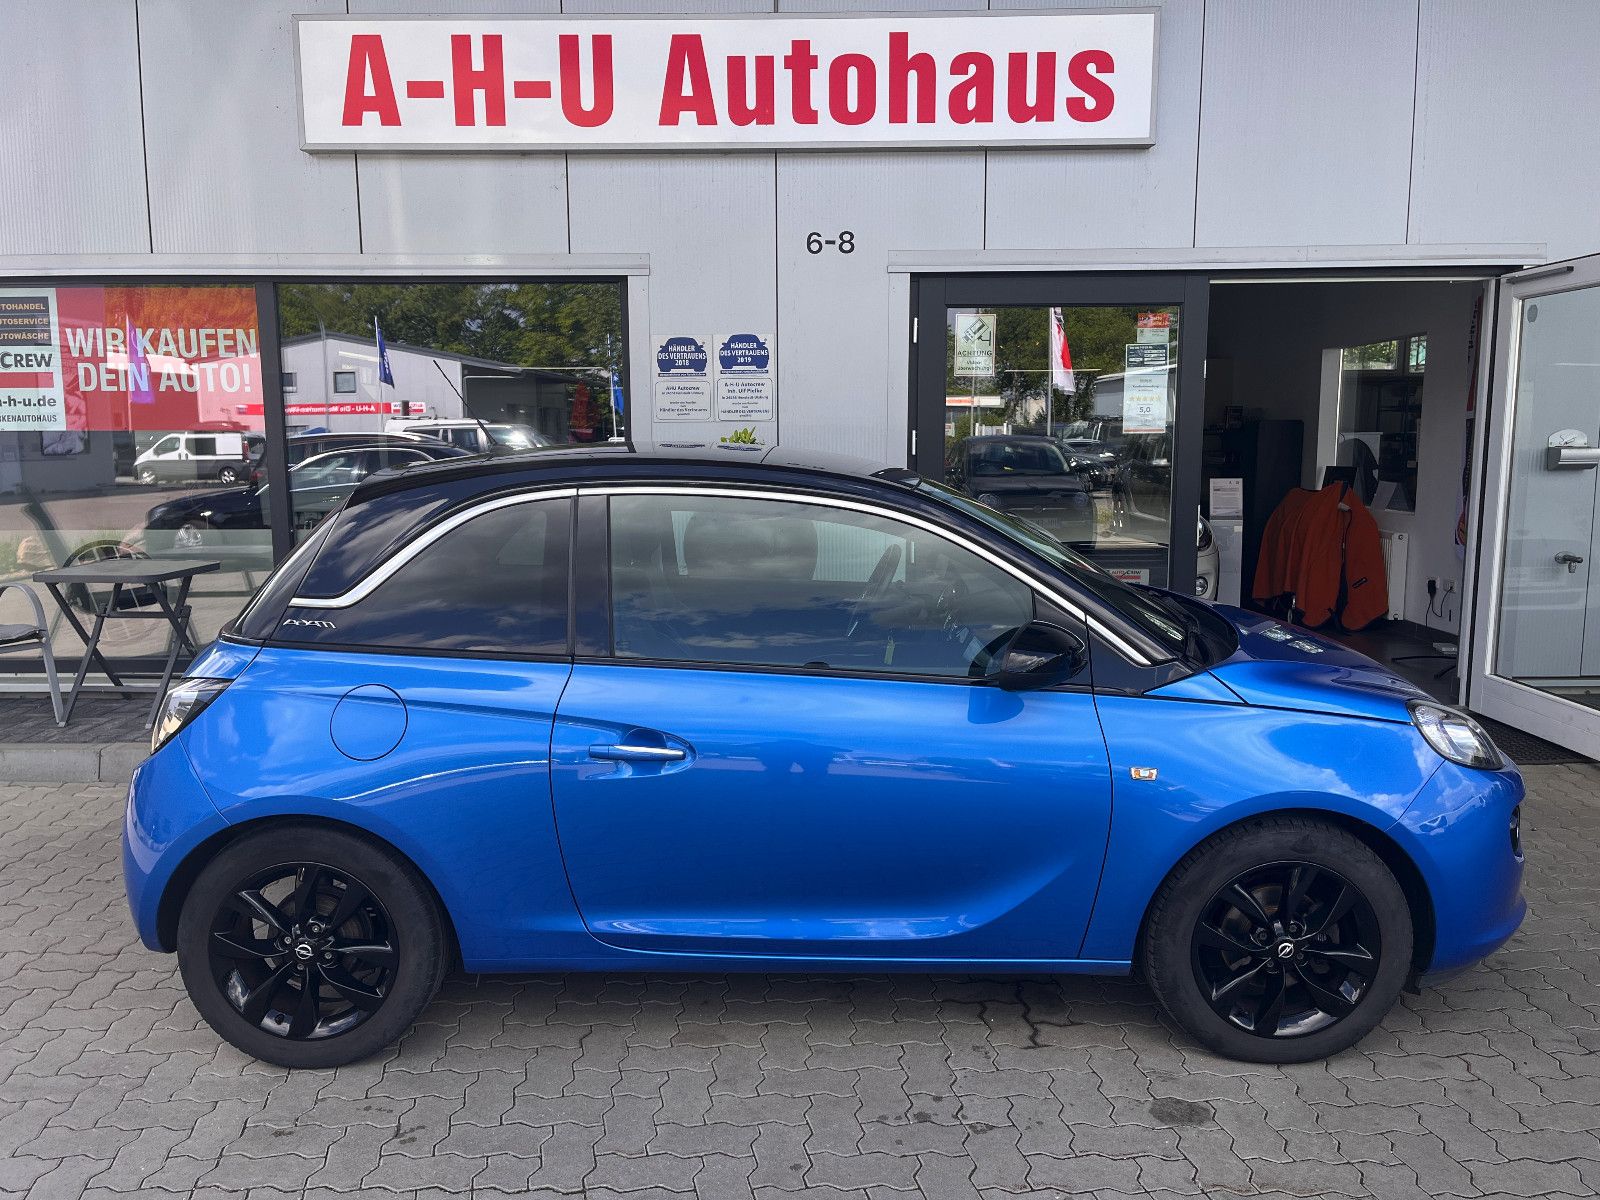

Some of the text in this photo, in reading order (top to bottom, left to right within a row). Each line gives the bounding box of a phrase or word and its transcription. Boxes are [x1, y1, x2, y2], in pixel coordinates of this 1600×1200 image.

[341, 31, 1116, 128] A-H-U Autohaus
[806, 230, 855, 255] 6-8
[0, 303, 46, 311] TOHANDEL
[65, 327, 257, 359] WIR KAUFEN
[668, 344, 695, 352] HÄNDLER
[658, 352, 706, 360] DES VERTRAUENS
[77, 362, 252, 393] DEIN AUTO!
